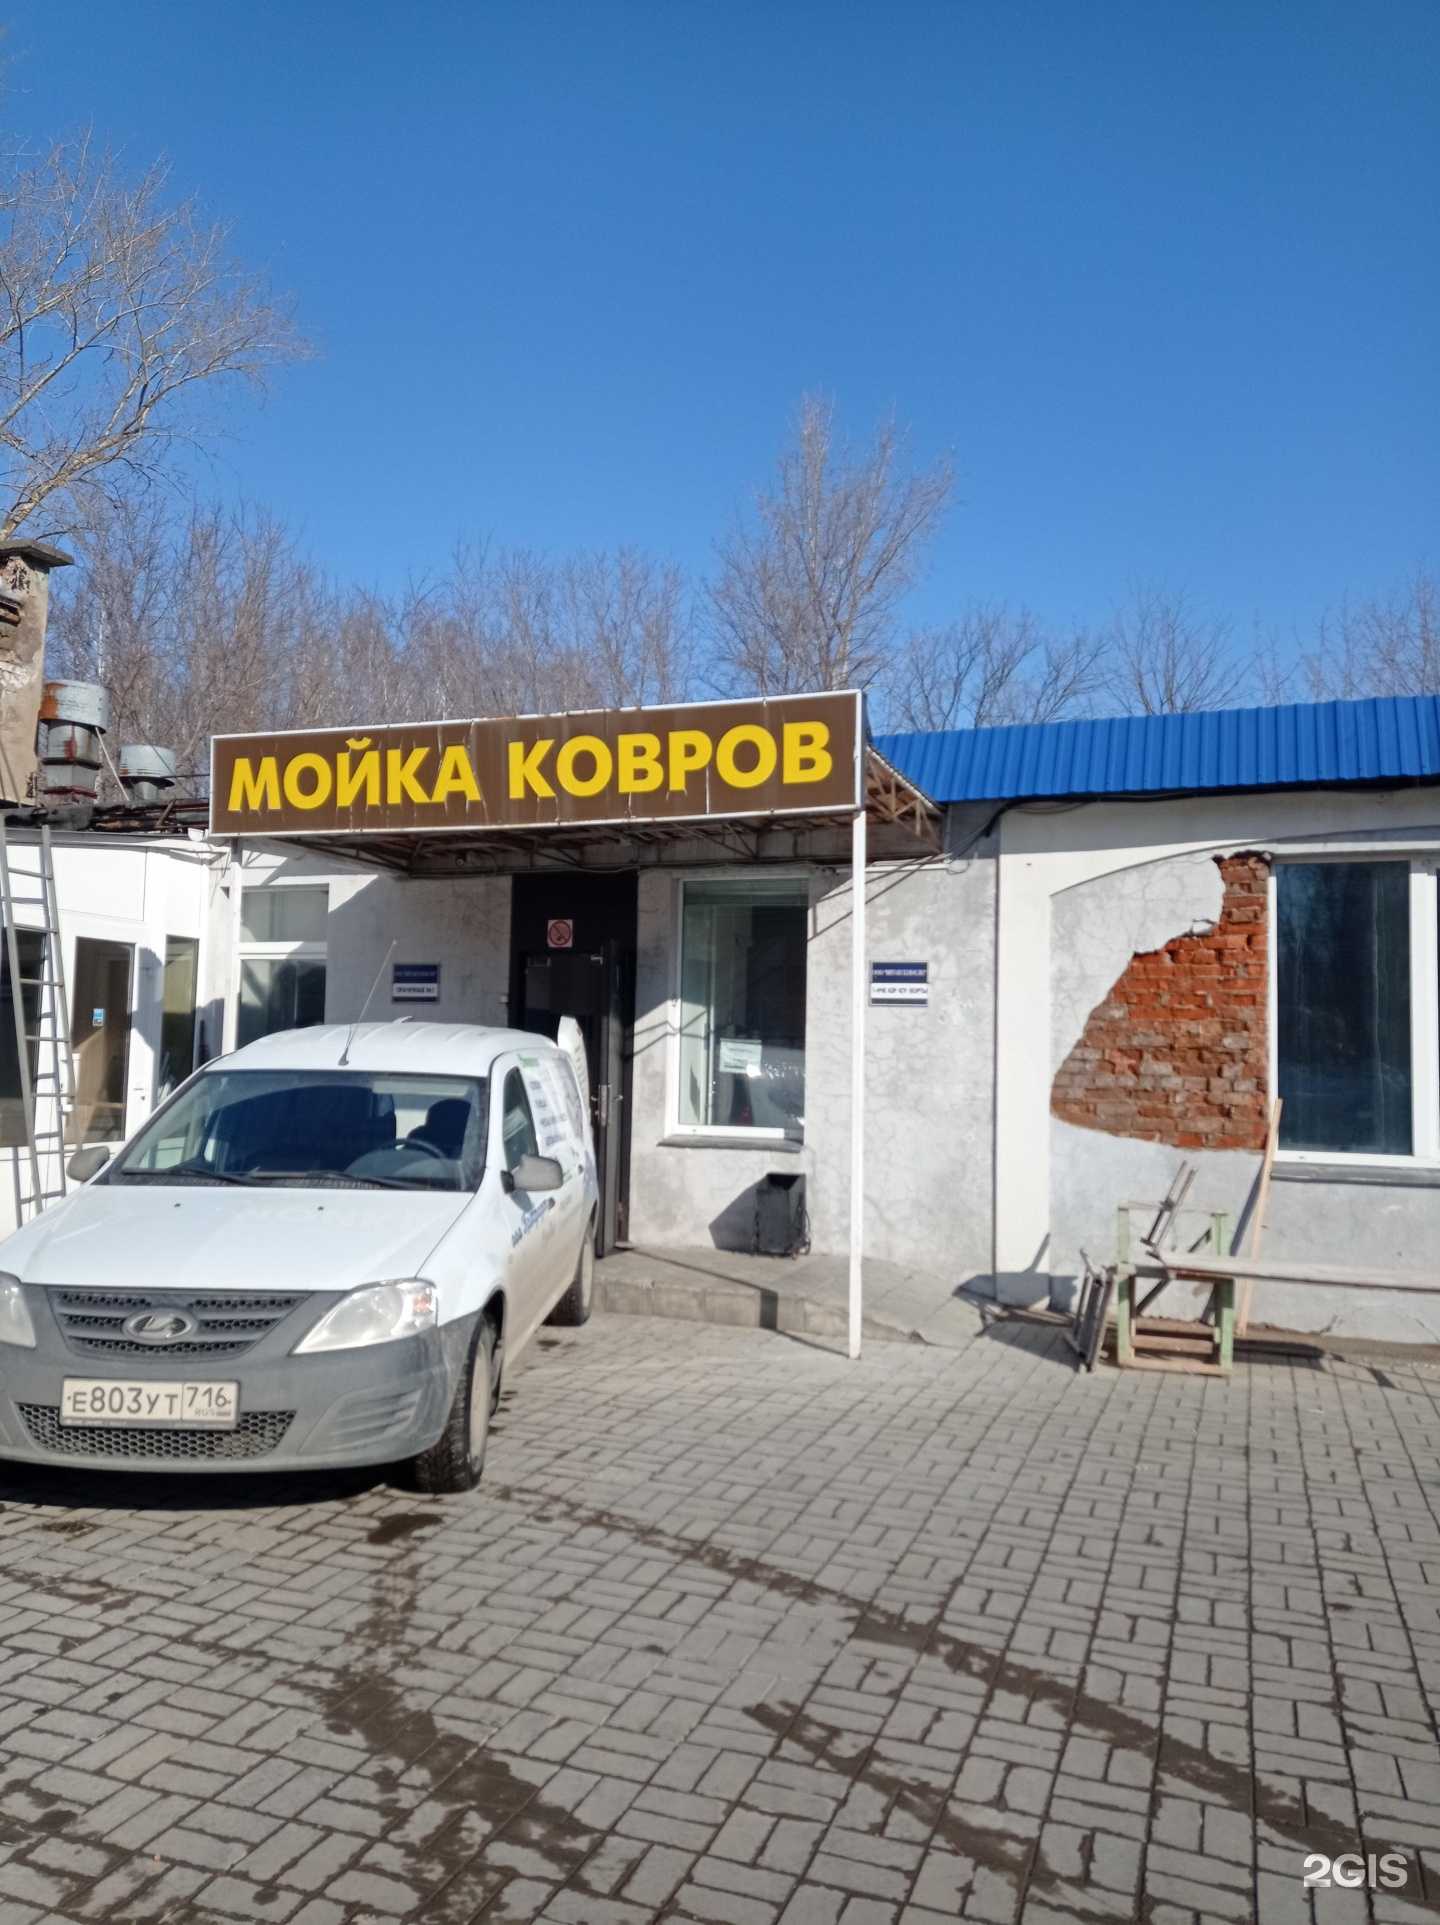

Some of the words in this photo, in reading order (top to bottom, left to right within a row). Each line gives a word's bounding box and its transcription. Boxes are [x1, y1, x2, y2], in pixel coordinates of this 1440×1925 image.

[227, 737, 482, 812] МОЙКА
[507, 720, 834, 801] КОВРОВ
[186, 1386, 228, 1408] 716
